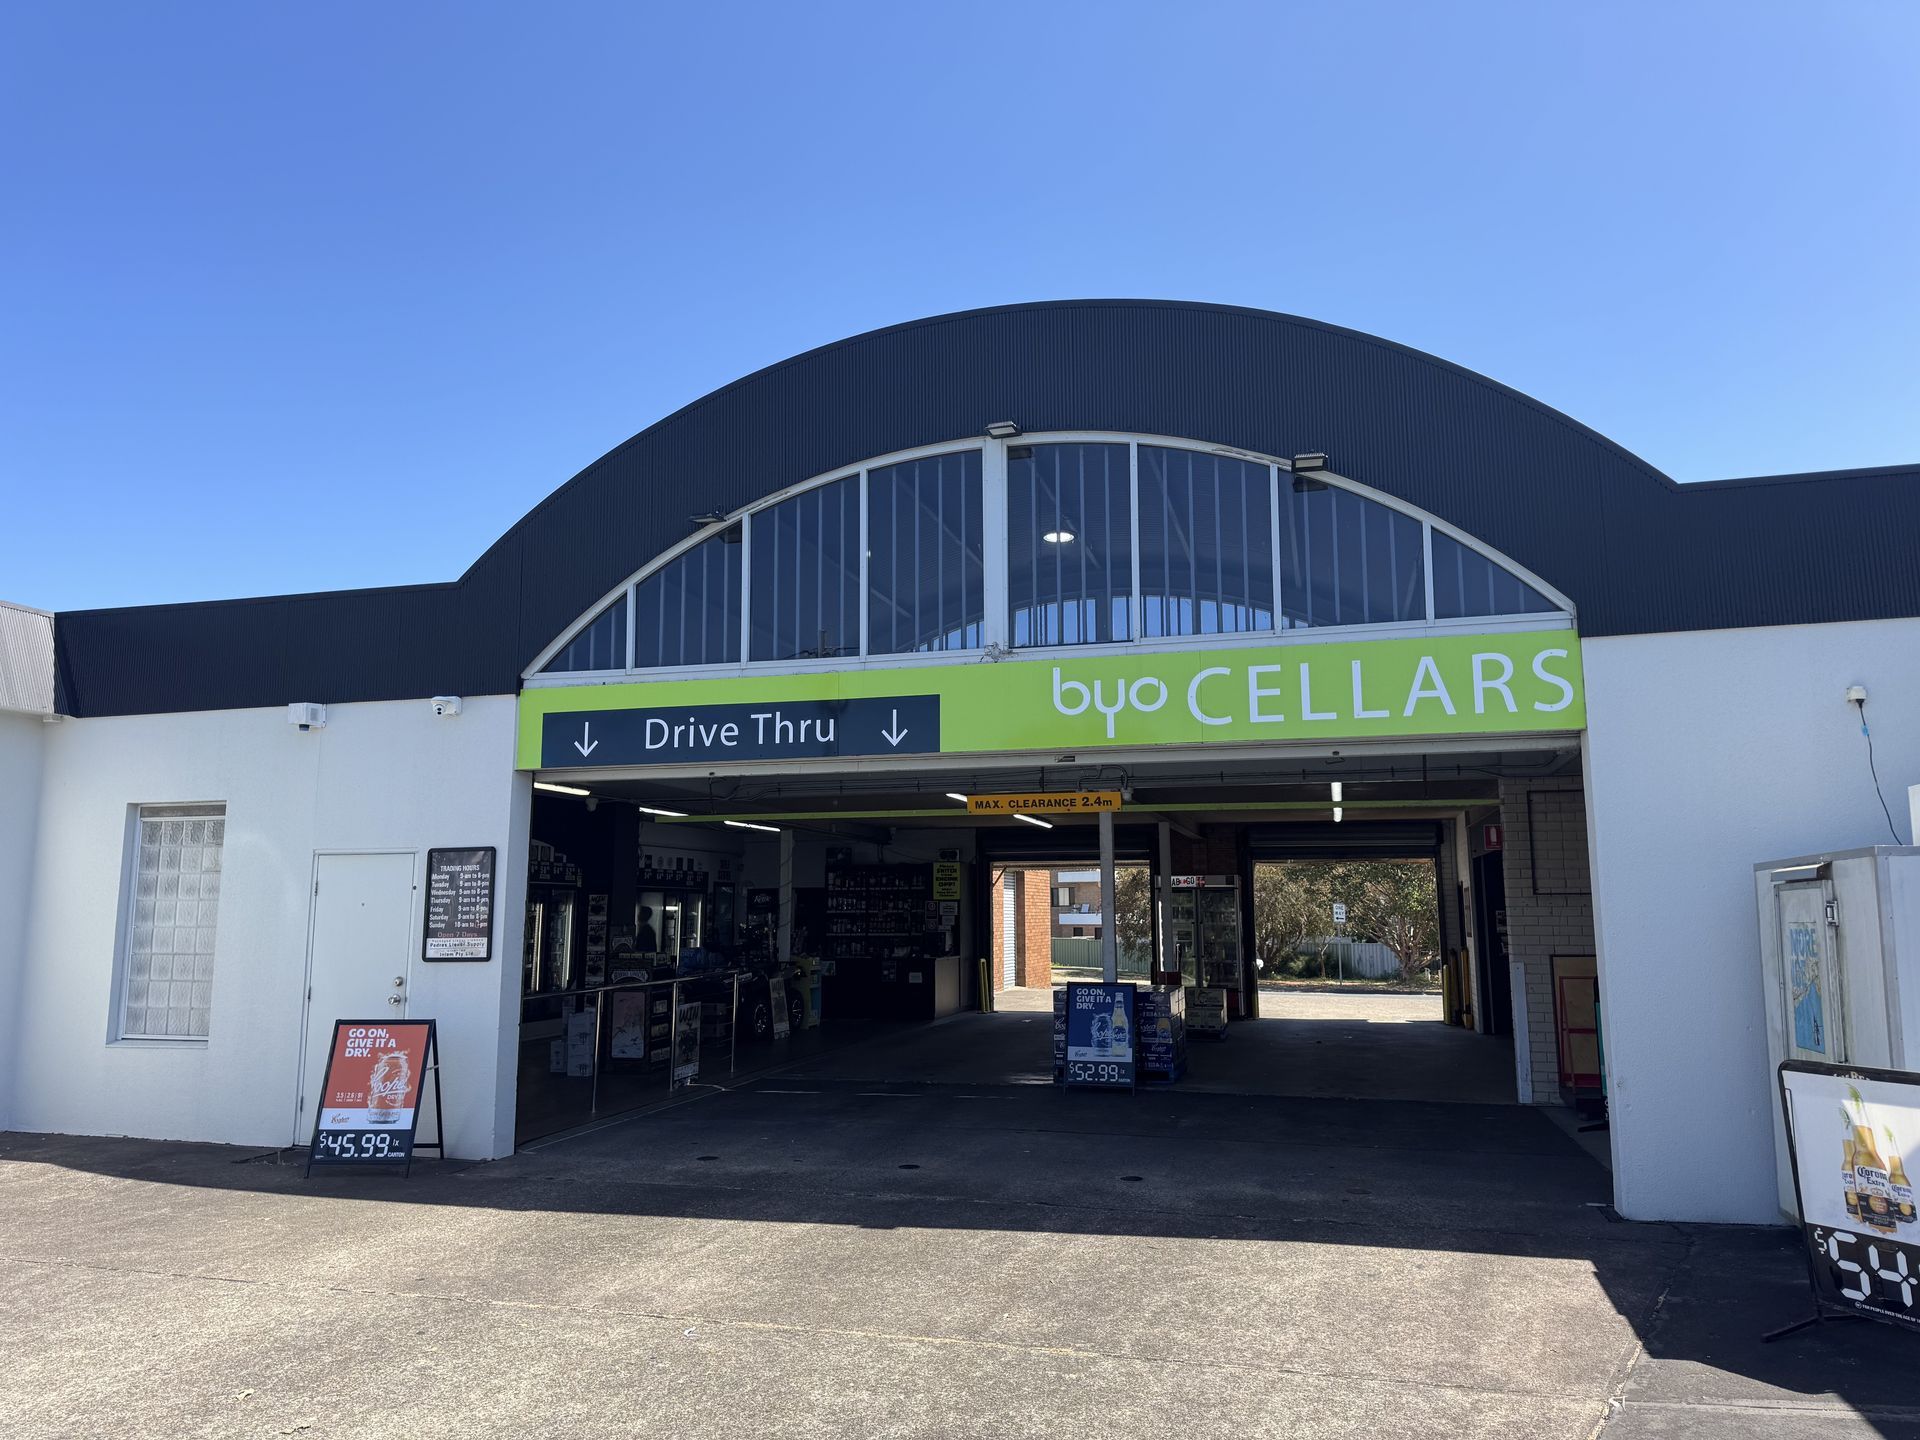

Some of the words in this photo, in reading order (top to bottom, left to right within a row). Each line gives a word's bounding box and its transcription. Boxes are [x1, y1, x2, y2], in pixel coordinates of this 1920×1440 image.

[1053, 668, 1167, 738] byo
[1188, 649, 1573, 725] CELLARS
[646, 719, 739, 748] Drive
[751, 712, 836, 745] Thru
[975, 800, 1003, 809] MAX.
[1008, 799, 1077, 808] CLEARANCE
[1082, 797, 1112, 806] 2.4m
[431, 889, 456, 897] Wednesday
[431, 897, 451, 905] Thursday
[429, 921, 446, 929] Sunday
[348, 1028, 366, 1038] GO
[367, 1028, 389, 1038] ON,
[346, 1038, 374, 1048] GIVE
[375, 1038, 387, 1048] IT
[387, 1038, 396, 1048] A
[344, 1048, 371, 1057] DRY.
[1069, 1061, 1118, 1082] $52.99
[320, 1131, 390, 1158] $45.99
[1857, 1166, 1888, 1180] Corona
[1866, 1177, 1886, 1187] Extra
[1870, 1306, 1884, 1314] PEOPLE
